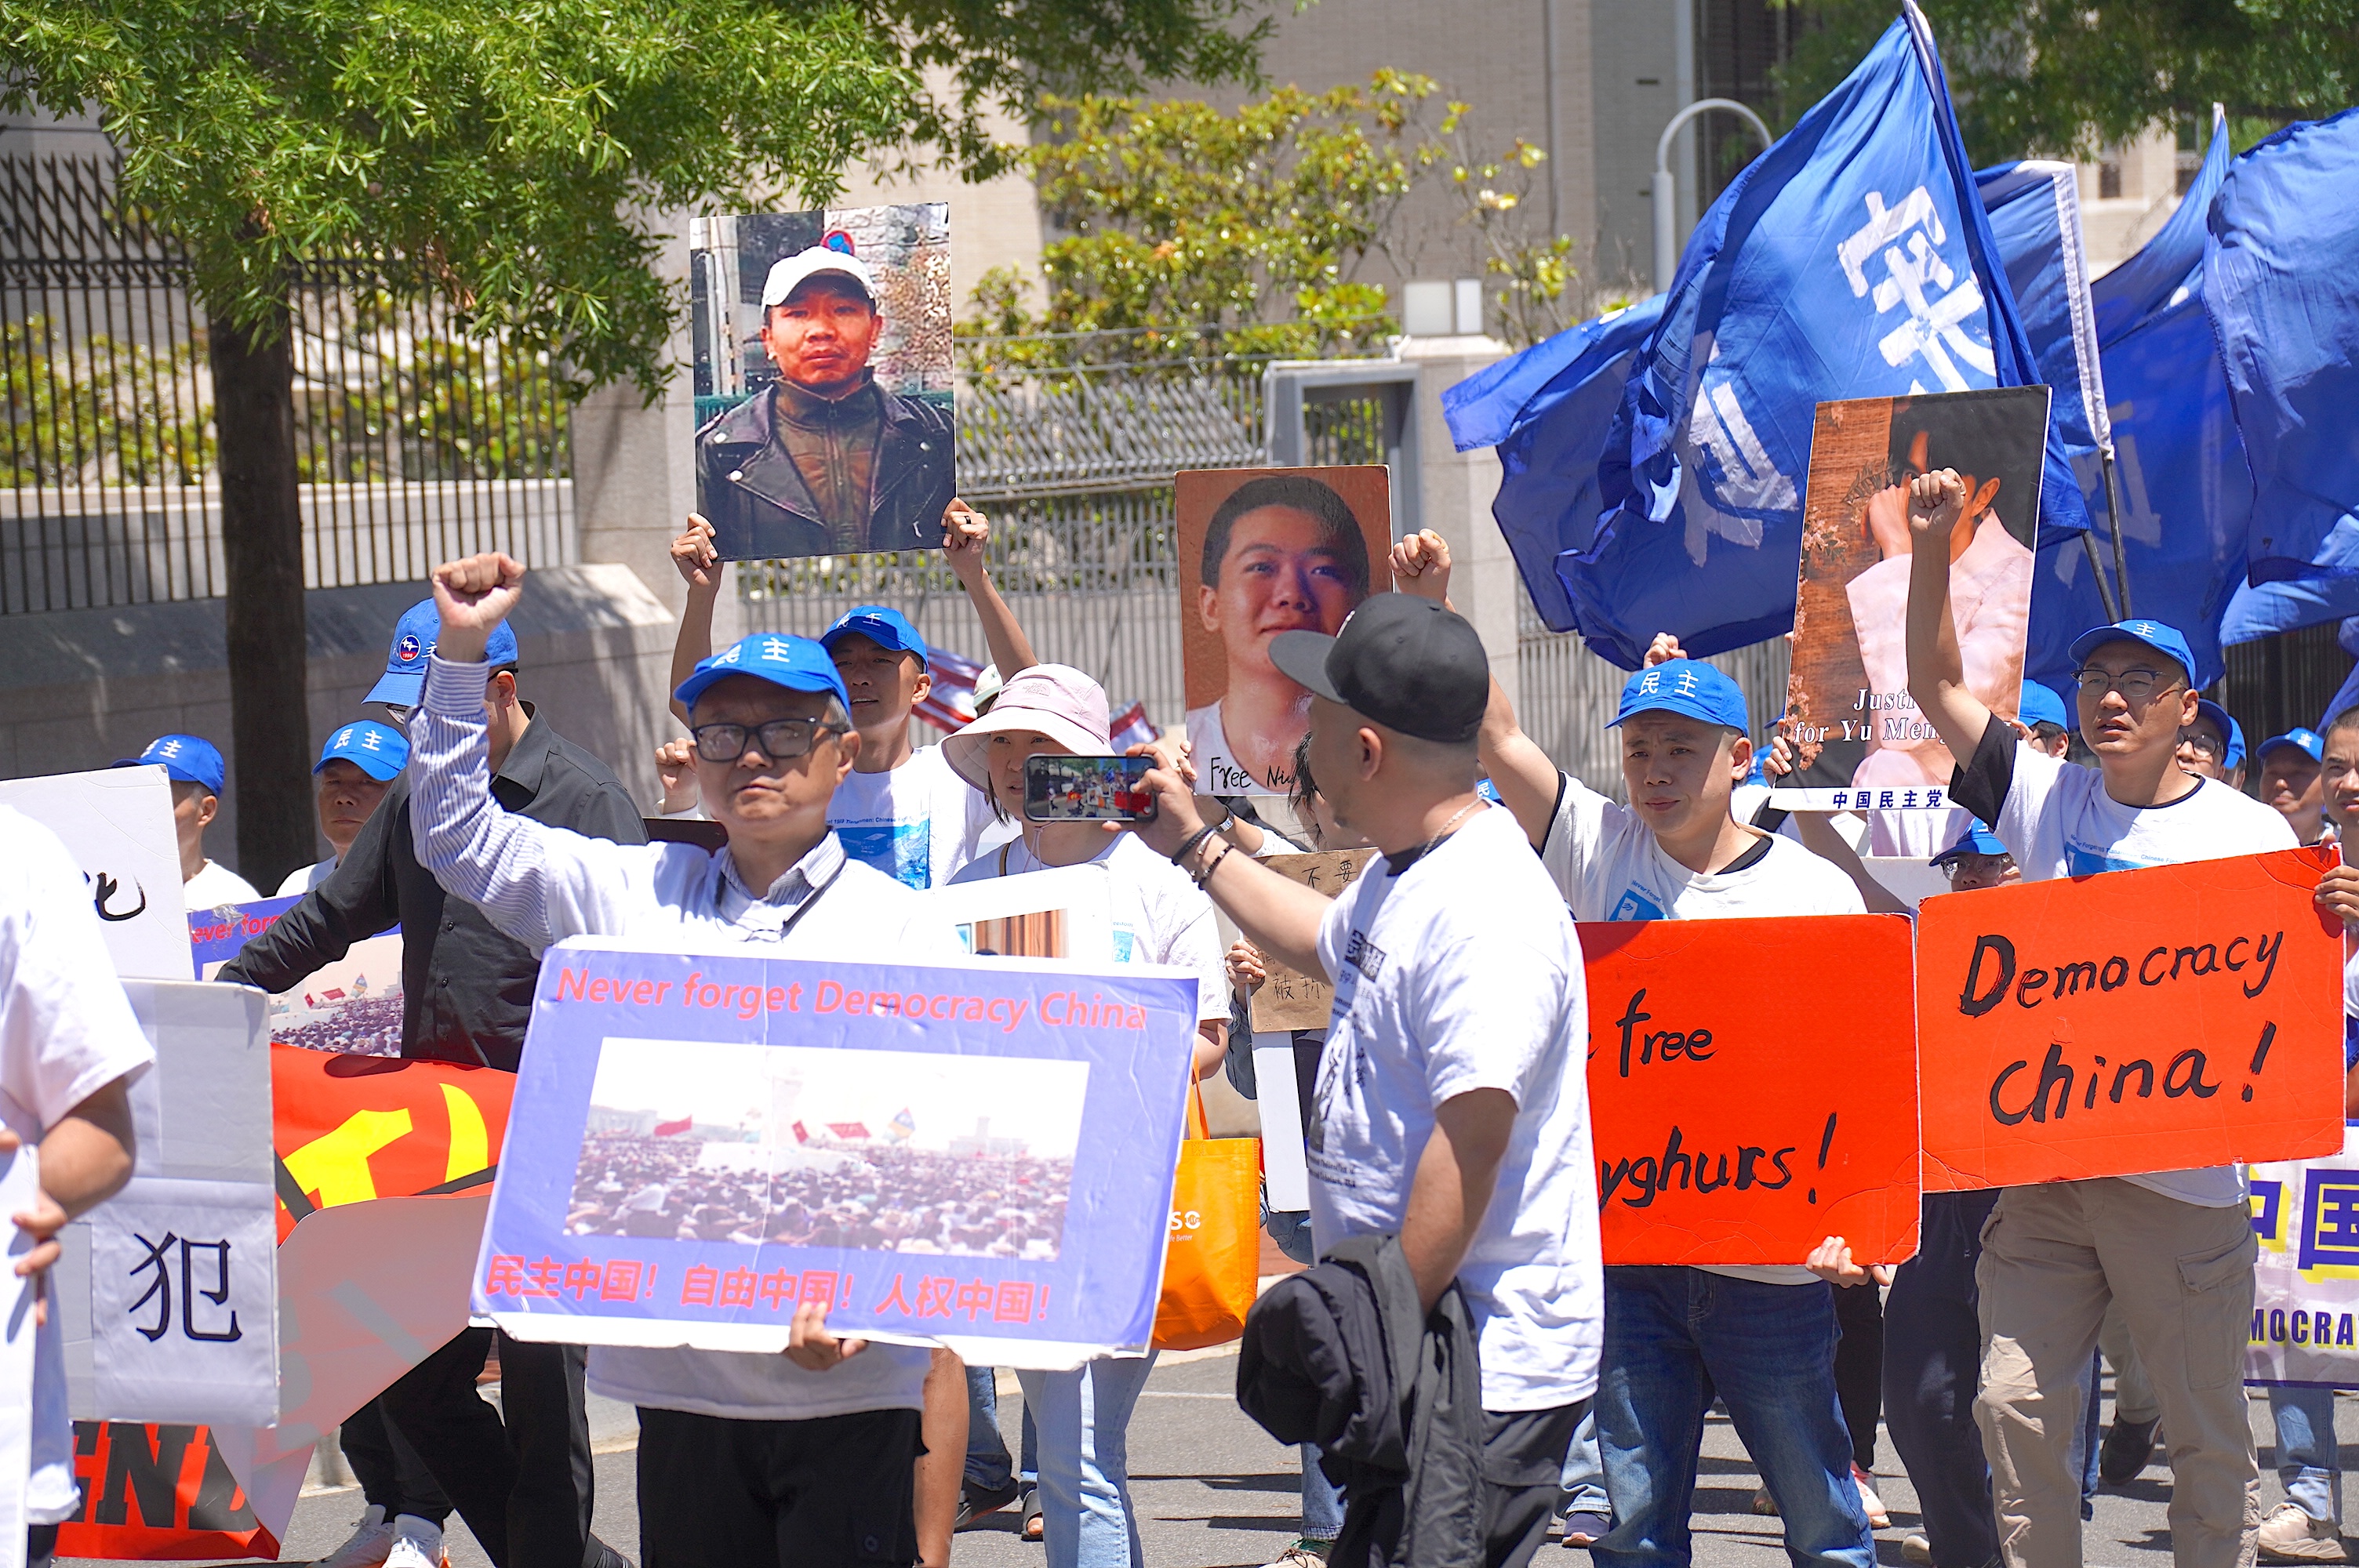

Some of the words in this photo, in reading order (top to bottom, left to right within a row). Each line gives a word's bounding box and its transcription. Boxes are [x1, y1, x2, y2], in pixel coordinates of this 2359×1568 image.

[711, 637, 791, 668] 民主
[1637, 669, 1699, 698] 民主
[333, 728, 382, 752] 民主
[1794, 721, 1830, 742] for
[1841, 719, 1873, 742] Yu
[1883, 717, 1946, 744] Men
[1211, 757, 1252, 791] Free
[1832, 789, 1943, 809] 中国民主党
[1302, 859, 1358, 889] 不要
[190, 923, 236, 944] ever
[1959, 931, 2284, 1018] Democracy
[556, 967, 671, 1006] Never
[683, 971, 803, 1020] forget
[814, 979, 1030, 1033] Democracy
[1040, 990, 1147, 1031] China
[1616, 988, 1719, 1077] free
[1600, 1112, 1837, 1209] yghurs!
[1170, 1210, 1201, 1231] SO
[128, 1231, 242, 1342] 犯
[2249, 1308, 2359, 1346] MOCRA
